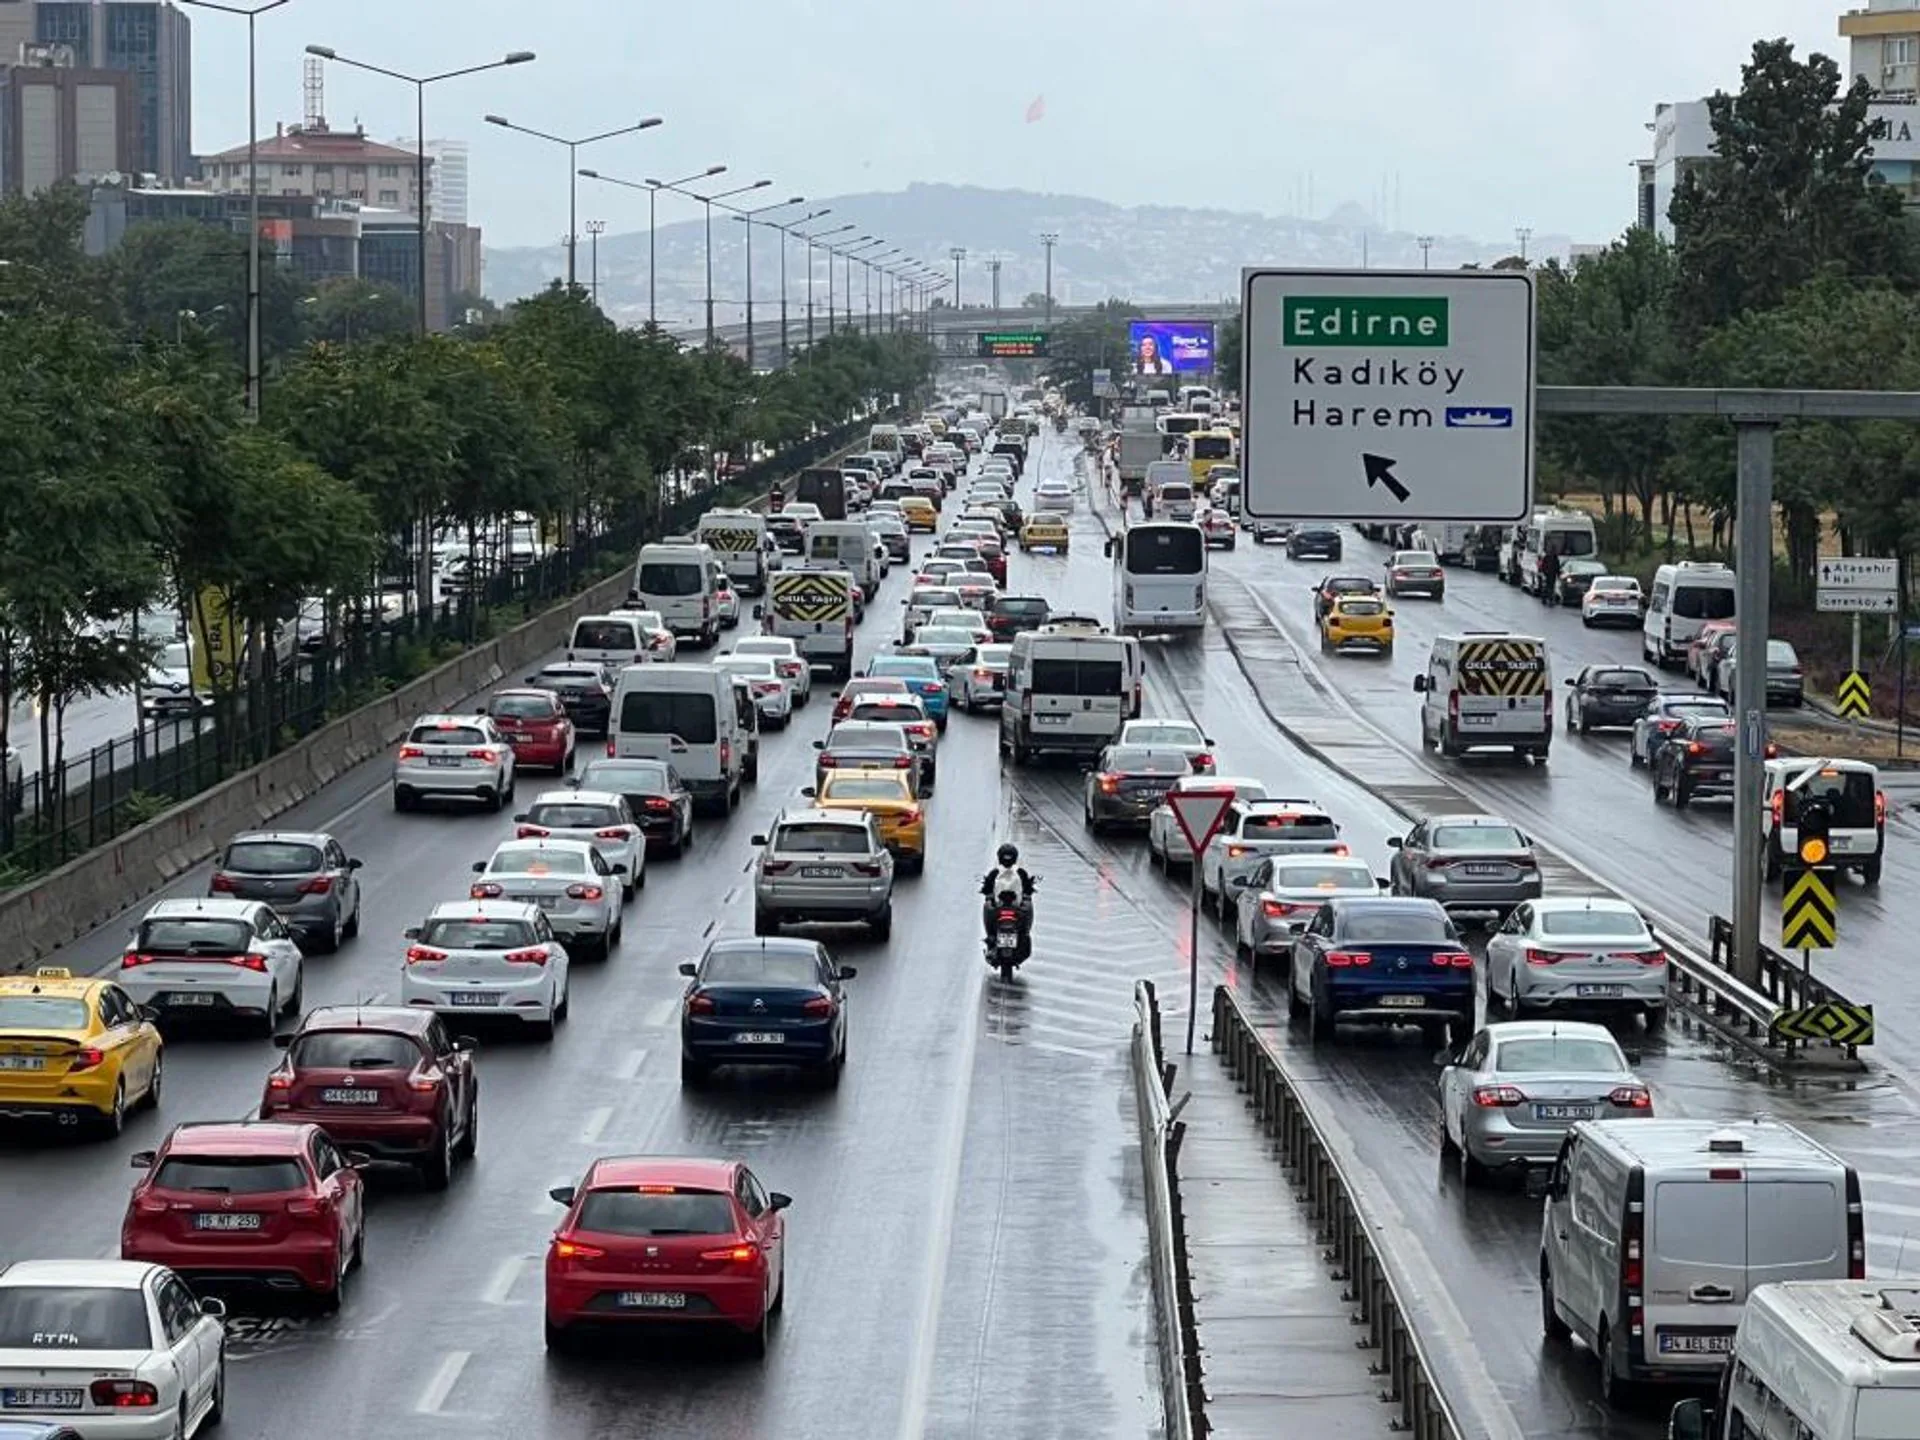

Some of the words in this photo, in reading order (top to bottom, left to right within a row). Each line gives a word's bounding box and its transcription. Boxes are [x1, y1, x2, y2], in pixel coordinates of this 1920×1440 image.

[1294, 308, 1437, 336] Edirne
[1294, 358, 1465, 394] Kadıköy
[1294, 400, 1432, 427] Harem
[237, 1214, 258, 1227] 250
